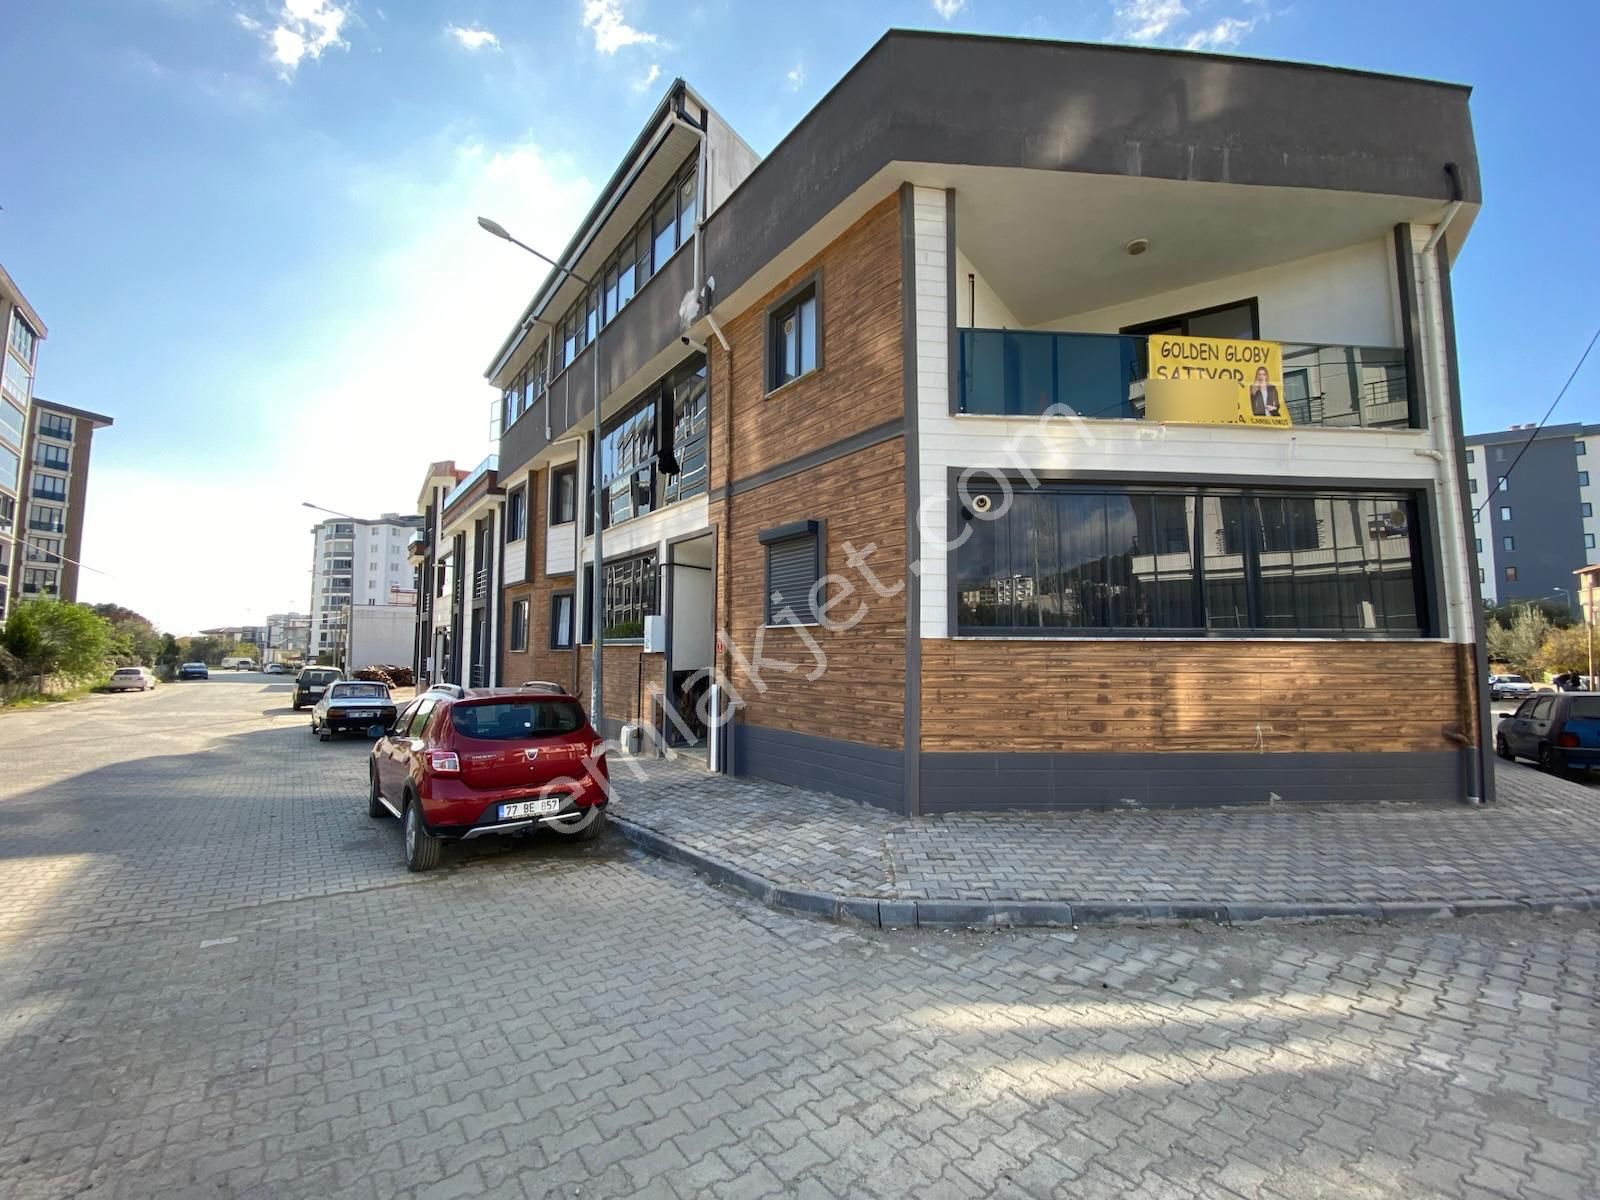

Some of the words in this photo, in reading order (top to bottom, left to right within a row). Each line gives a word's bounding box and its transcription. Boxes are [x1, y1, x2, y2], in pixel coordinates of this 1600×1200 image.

[1161, 341, 1219, 361] GOLDEN
[1225, 344, 1270, 364] GLOBY
[506, 804, 518, 816] 77
[523, 802, 535, 814] BE
